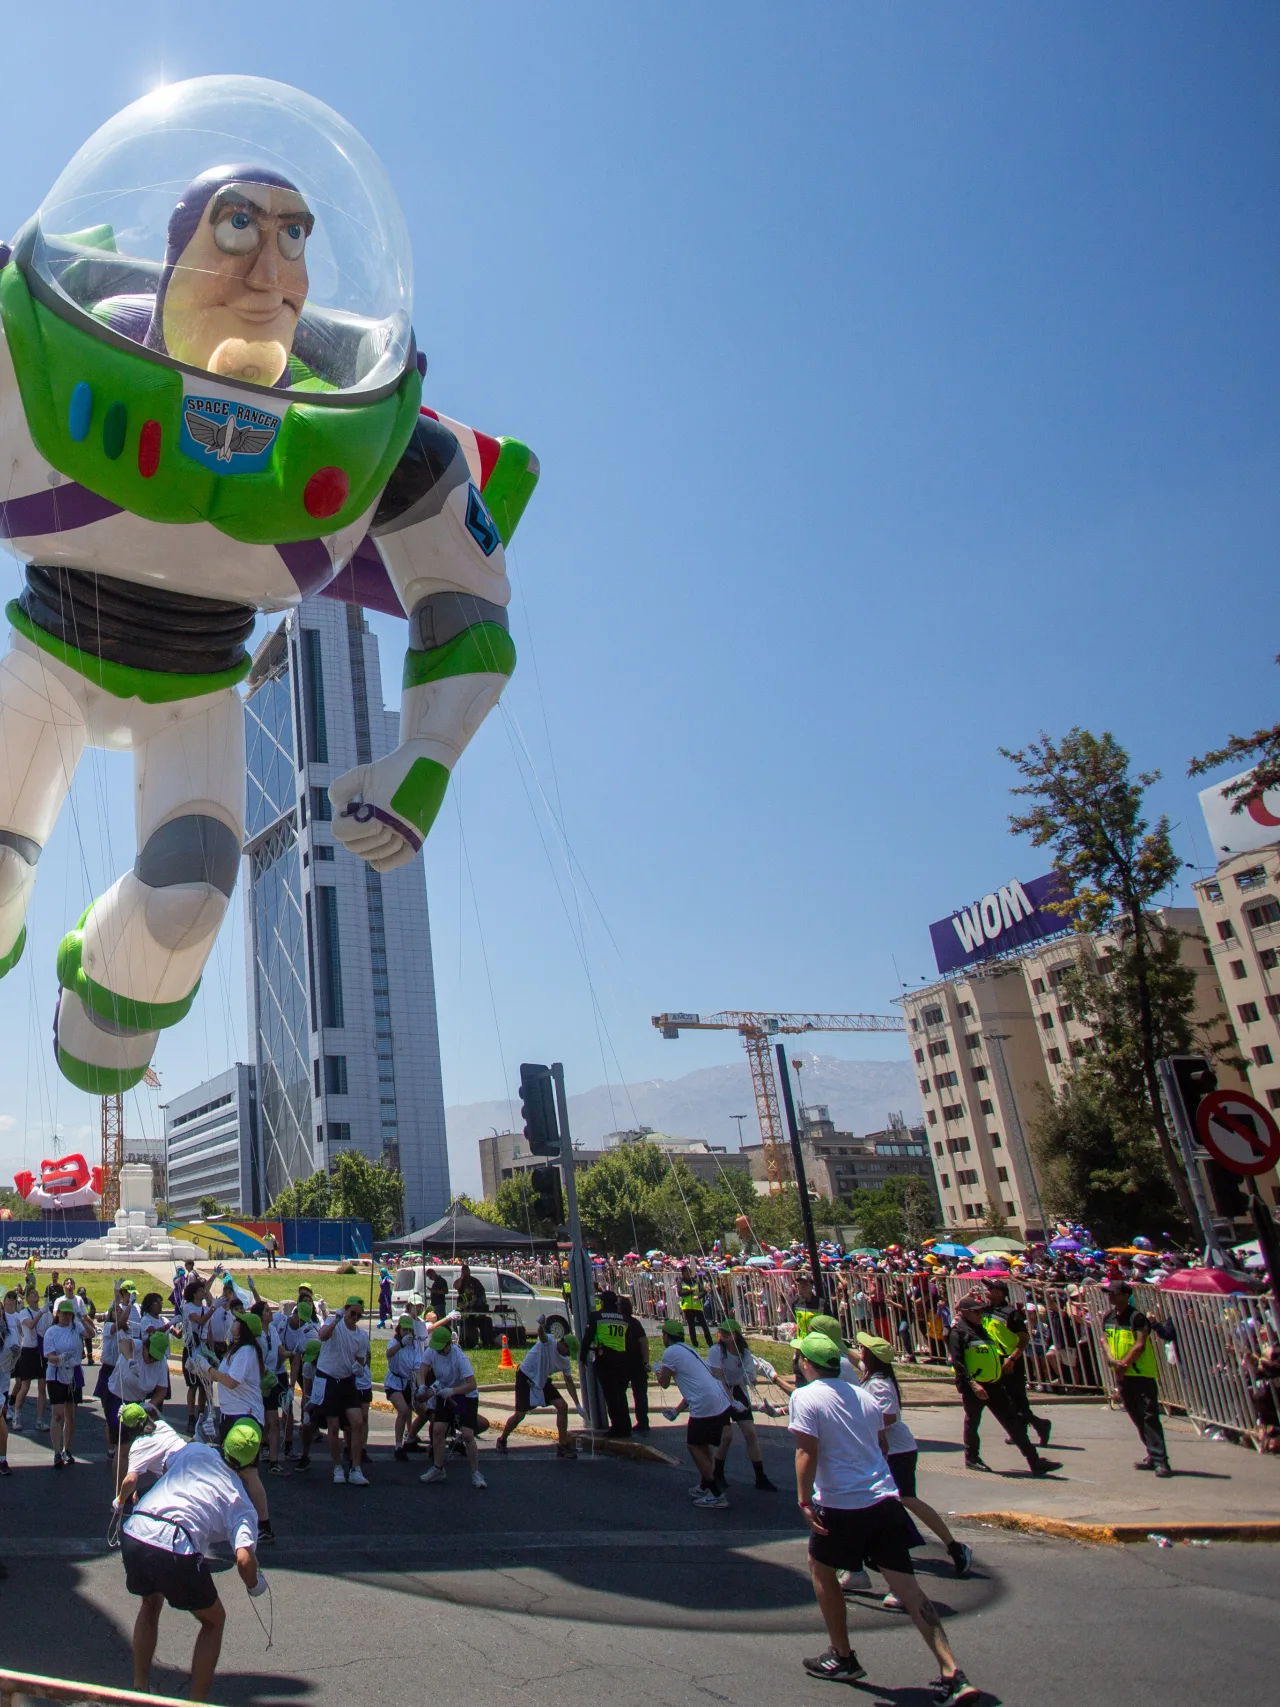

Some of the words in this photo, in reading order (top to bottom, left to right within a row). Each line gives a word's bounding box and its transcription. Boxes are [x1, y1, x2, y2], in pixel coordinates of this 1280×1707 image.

[187, 399, 230, 416] SPACE
[236, 406, 279, 429] RANGER
[951, 877, 1035, 954] WOM
[7, 1243, 69, 1259] Santia
[608, 1325, 624, 1337] 170
